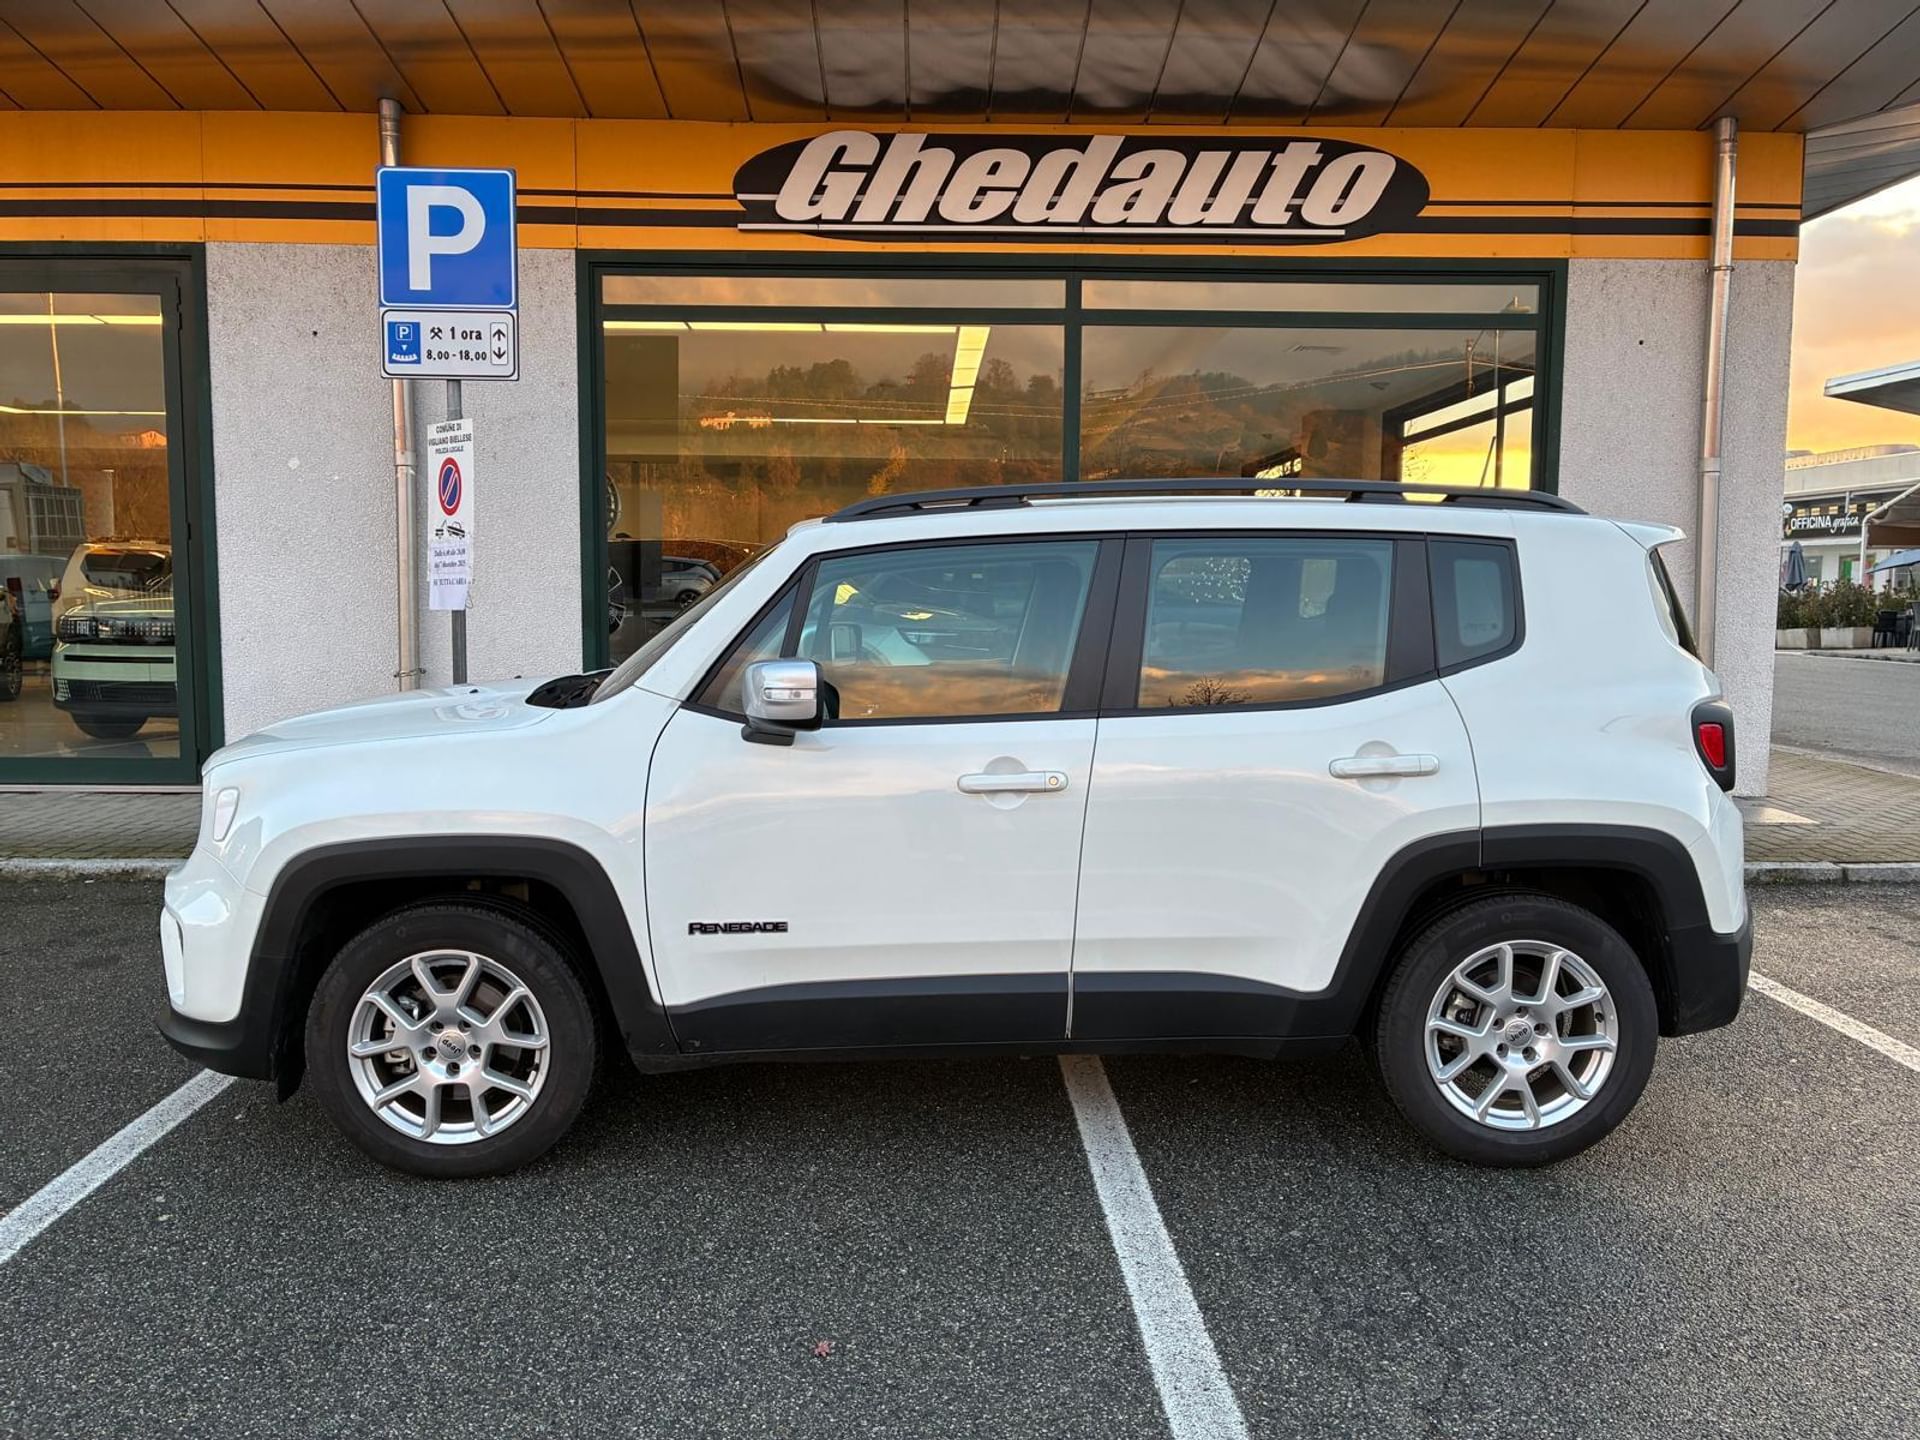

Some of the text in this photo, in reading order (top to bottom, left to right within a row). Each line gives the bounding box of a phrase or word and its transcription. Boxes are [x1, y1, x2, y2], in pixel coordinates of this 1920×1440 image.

[775, 130, 1396, 225] Ghedauto
[406, 184, 486, 291] P
[449, 326, 482, 340] 1 ora
[1790, 515, 1832, 530] OFFICINA
[688, 921, 788, 936] RENEGADE
